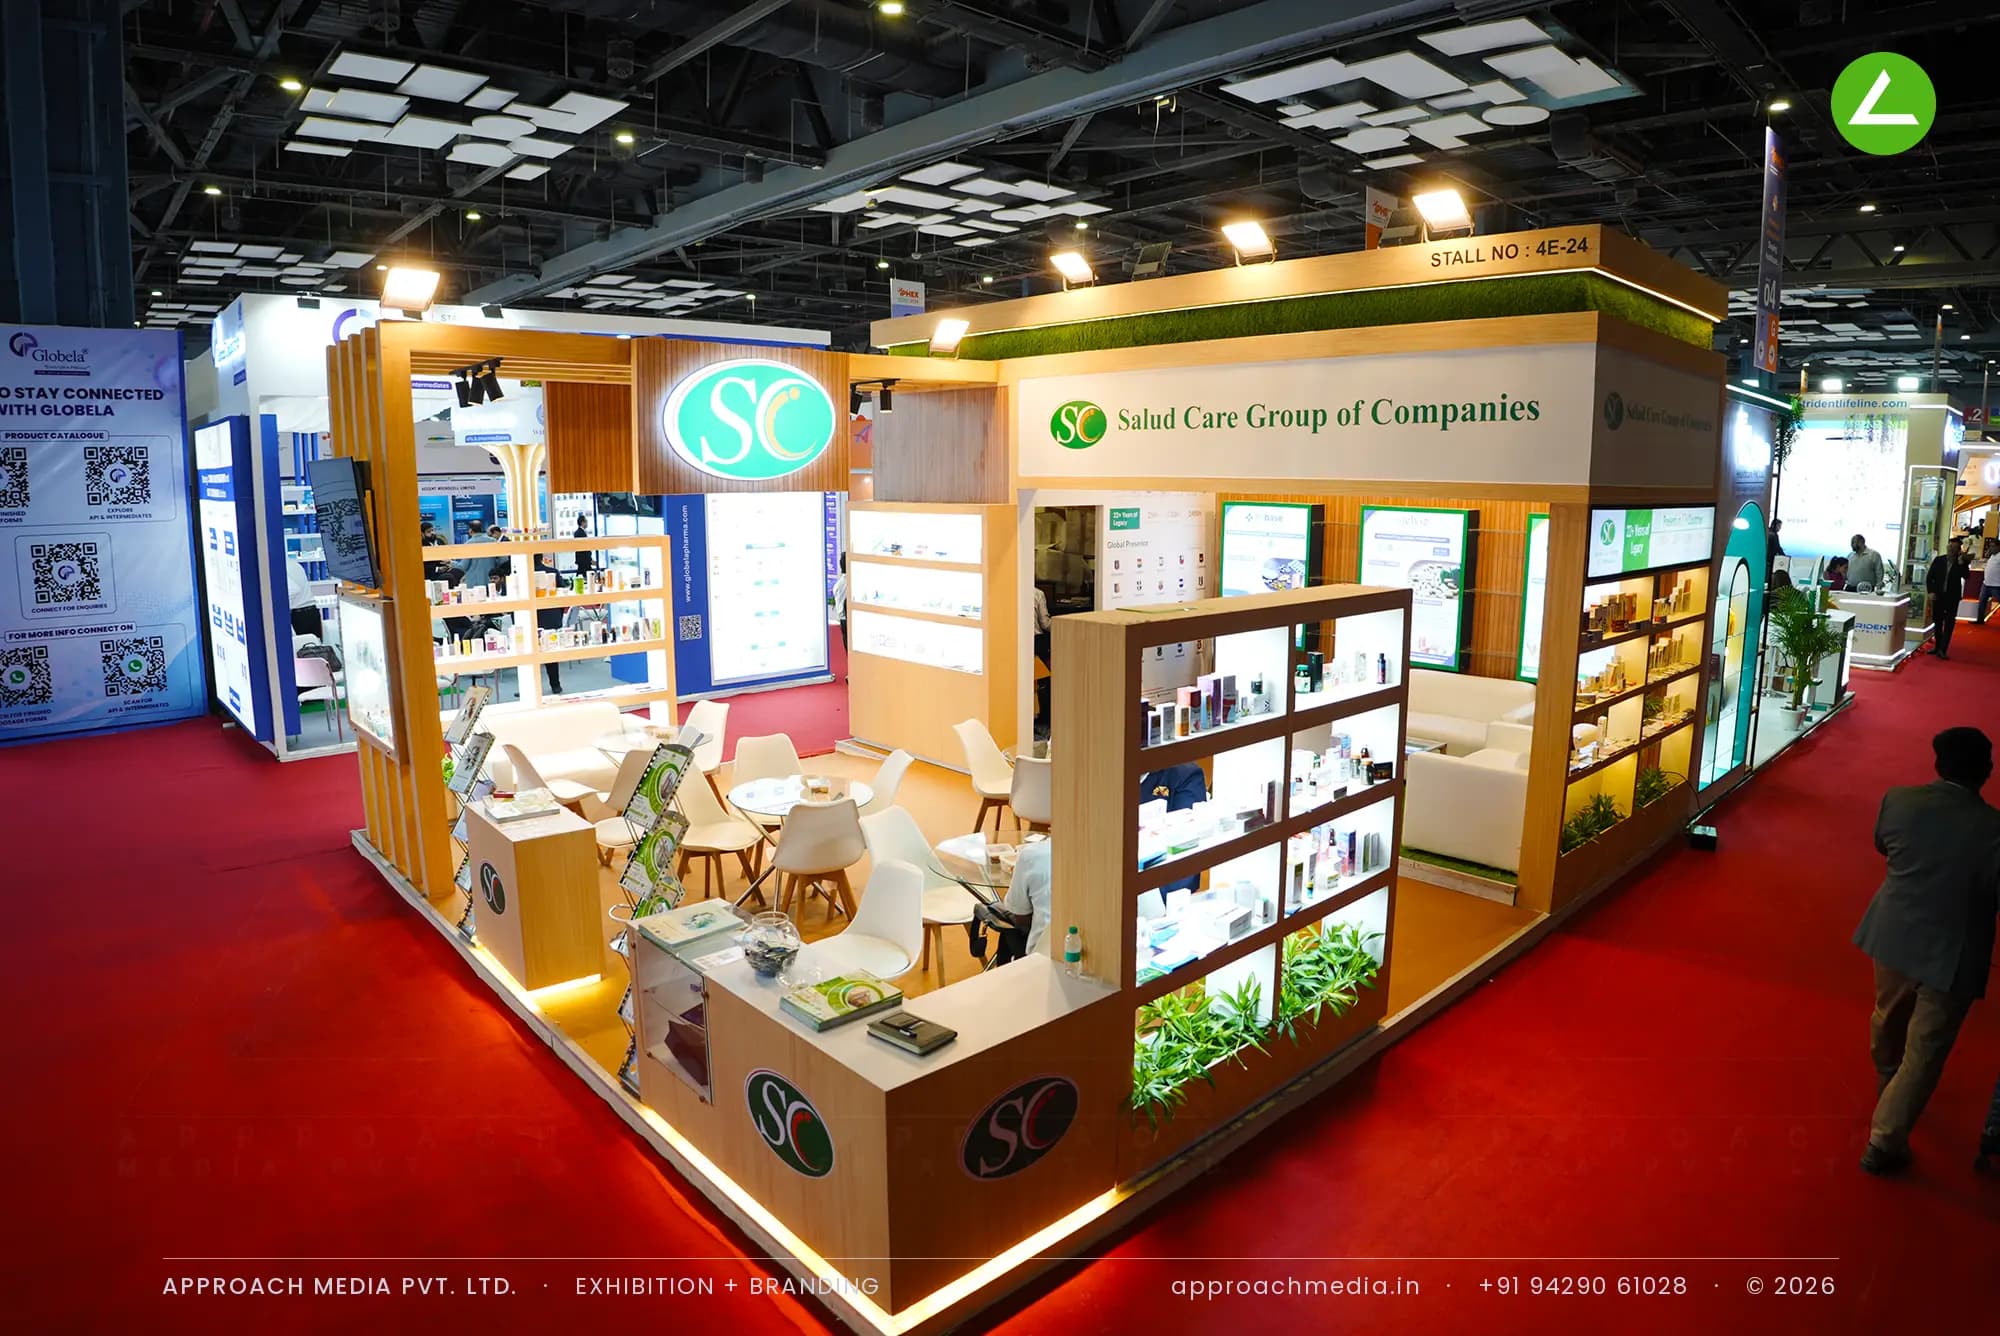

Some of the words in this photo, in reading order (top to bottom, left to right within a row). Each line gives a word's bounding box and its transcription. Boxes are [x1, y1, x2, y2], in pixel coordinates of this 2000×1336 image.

[1431, 249, 1486, 268] STALL
[1492, 243, 1519, 261] NO
[1535, 236, 1589, 257] 4E-24
[0, 387, 11, 399] O
[15, 387, 59, 399] STAY
[63, 388, 164, 401] CONNECTED
[40, 404, 115, 416] GLOBELA
[1118, 406, 1176, 432] Salud
[1184, 405, 1239, 430] Care
[1246, 402, 1328, 434] Group
[1337, 399, 1366, 427] of
[1371, 393, 1541, 434] Companies
[1107, 541, 1124, 550] Global
[31, 606, 62, 614] CONNECT
[9, 630, 27, 640] FOR
[28, 629, 54, 639] MORE
[55, 627, 76, 637] INFO
[77, 625, 119, 635] CONNECT
[120, 623, 134, 632] ON
[1855, 622, 1894, 631] RIDENT
